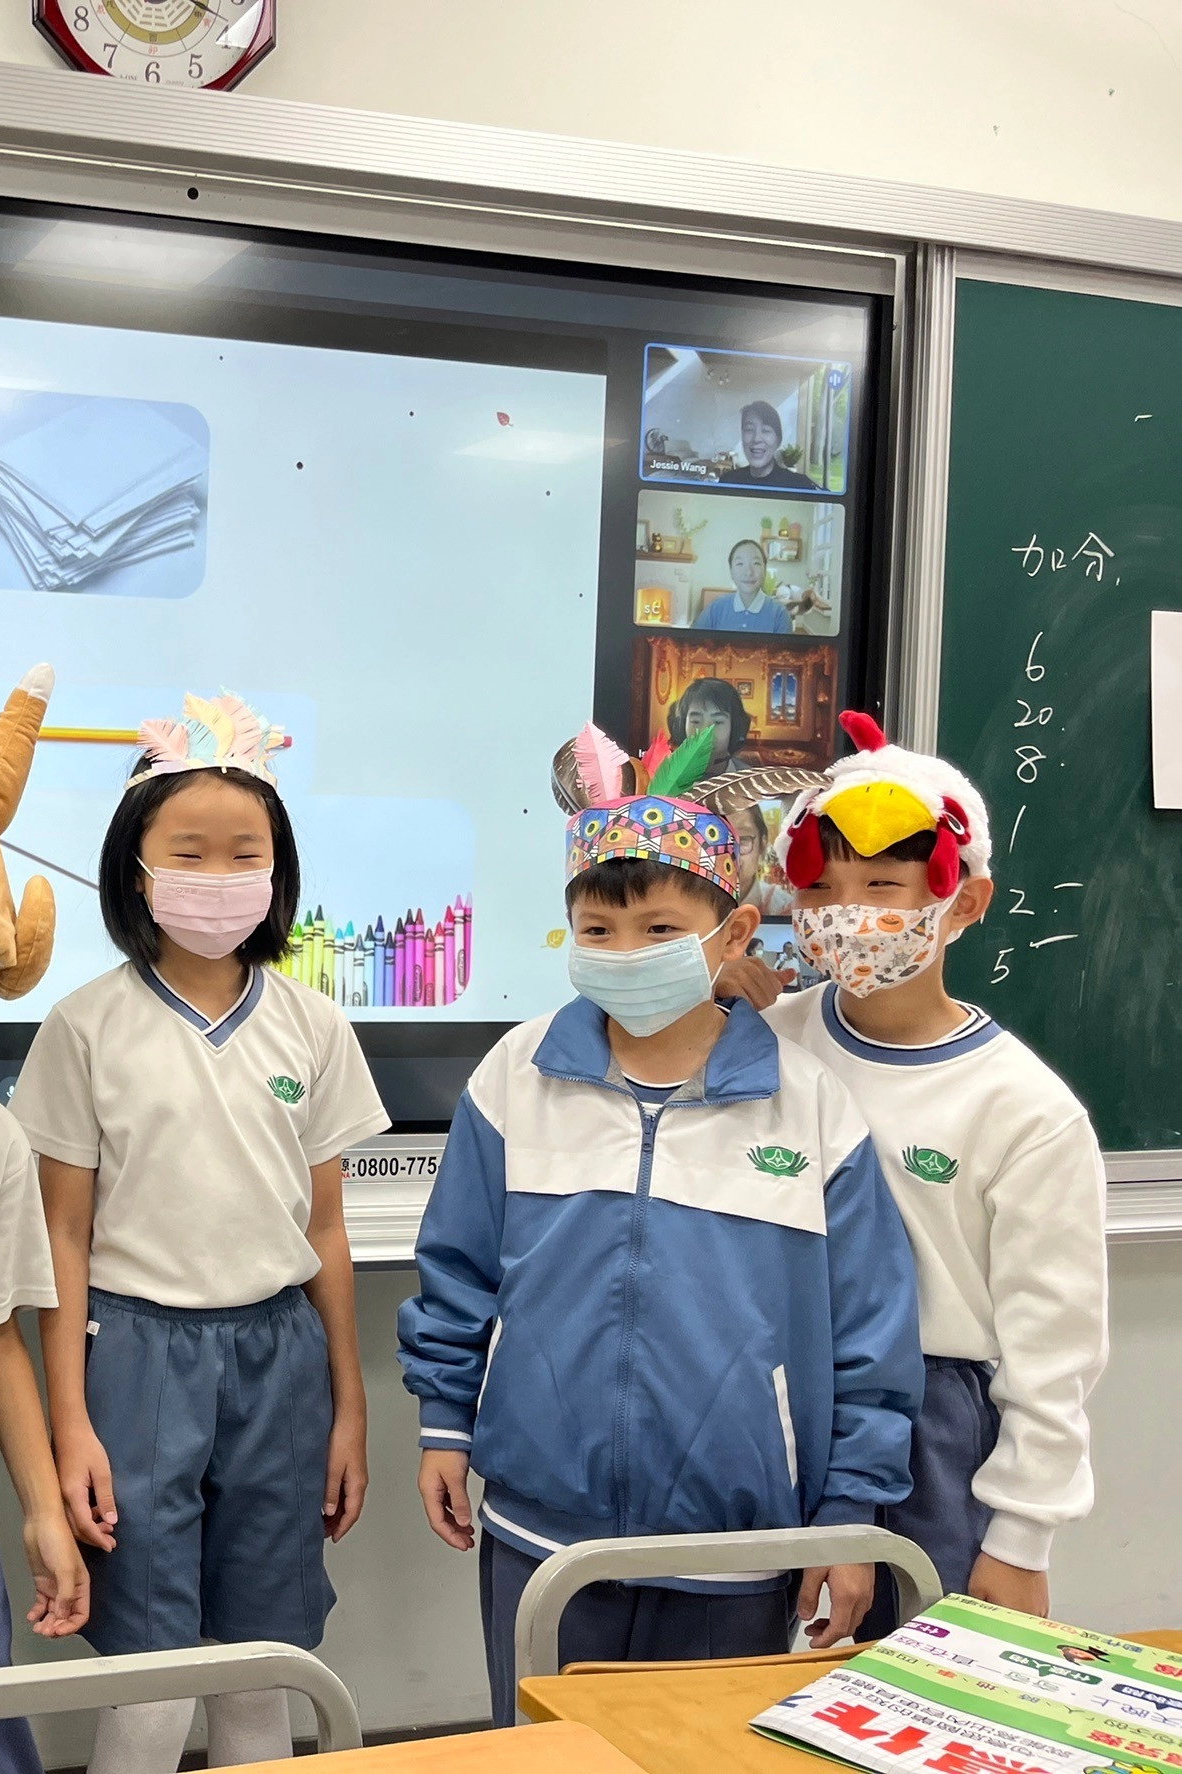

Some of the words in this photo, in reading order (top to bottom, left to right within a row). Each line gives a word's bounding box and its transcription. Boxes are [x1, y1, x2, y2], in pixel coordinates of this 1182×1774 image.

[73, 6, 90, 32] 8
[103, 43, 119, 69] 7
[188, 53, 204, 79] 5
[145, 61, 162, 84] 6
[650, 459, 679, 471] Jessie
[681, 461, 707, 475] Wang
[1025, 631, 1045, 682] 6
